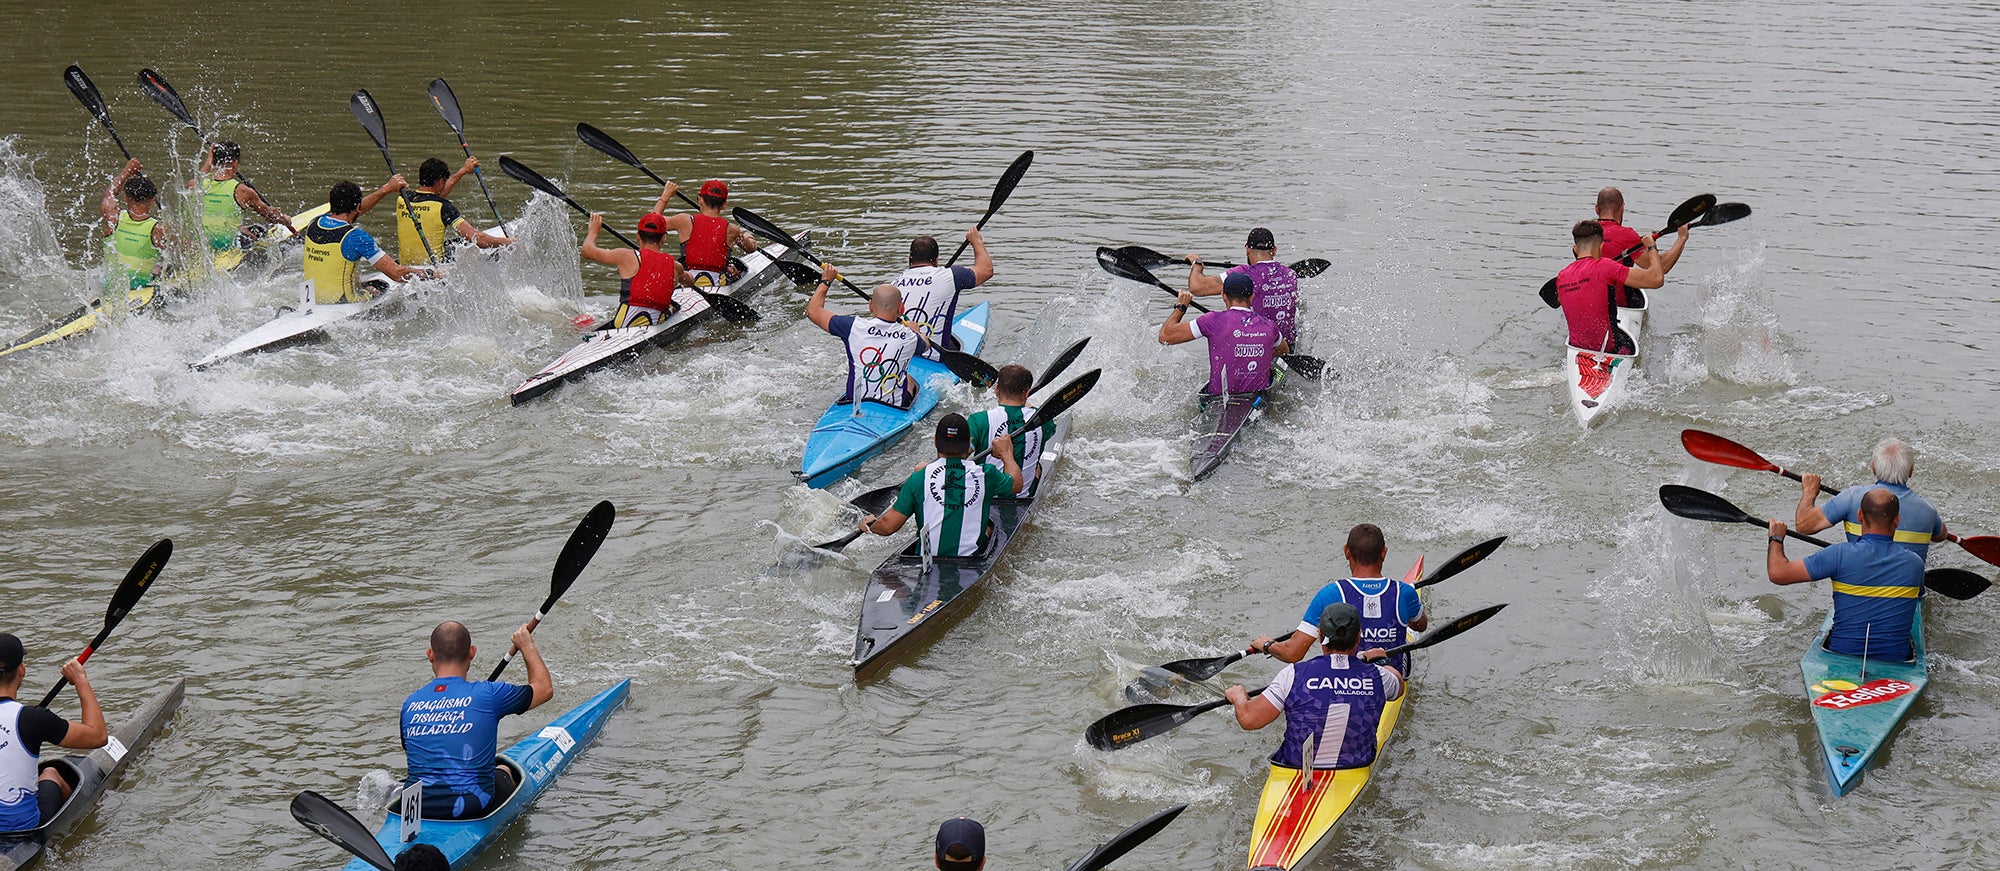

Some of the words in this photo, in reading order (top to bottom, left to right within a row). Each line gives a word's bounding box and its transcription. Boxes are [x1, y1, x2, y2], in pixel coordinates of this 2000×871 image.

[867, 326, 907, 340] CANOE
[1234, 346, 1265, 358] MUNDO
[929, 482, 942, 502] ALAR
[1306, 677, 1374, 690] CANOE
[1820, 682, 1910, 707] Helios
[406, 696, 472, 712] PIRAGÜISMO
[410, 710, 465, 724] PISUERGA
[406, 722, 473, 738] VALLADOLID
[404, 791, 420, 826] 461
